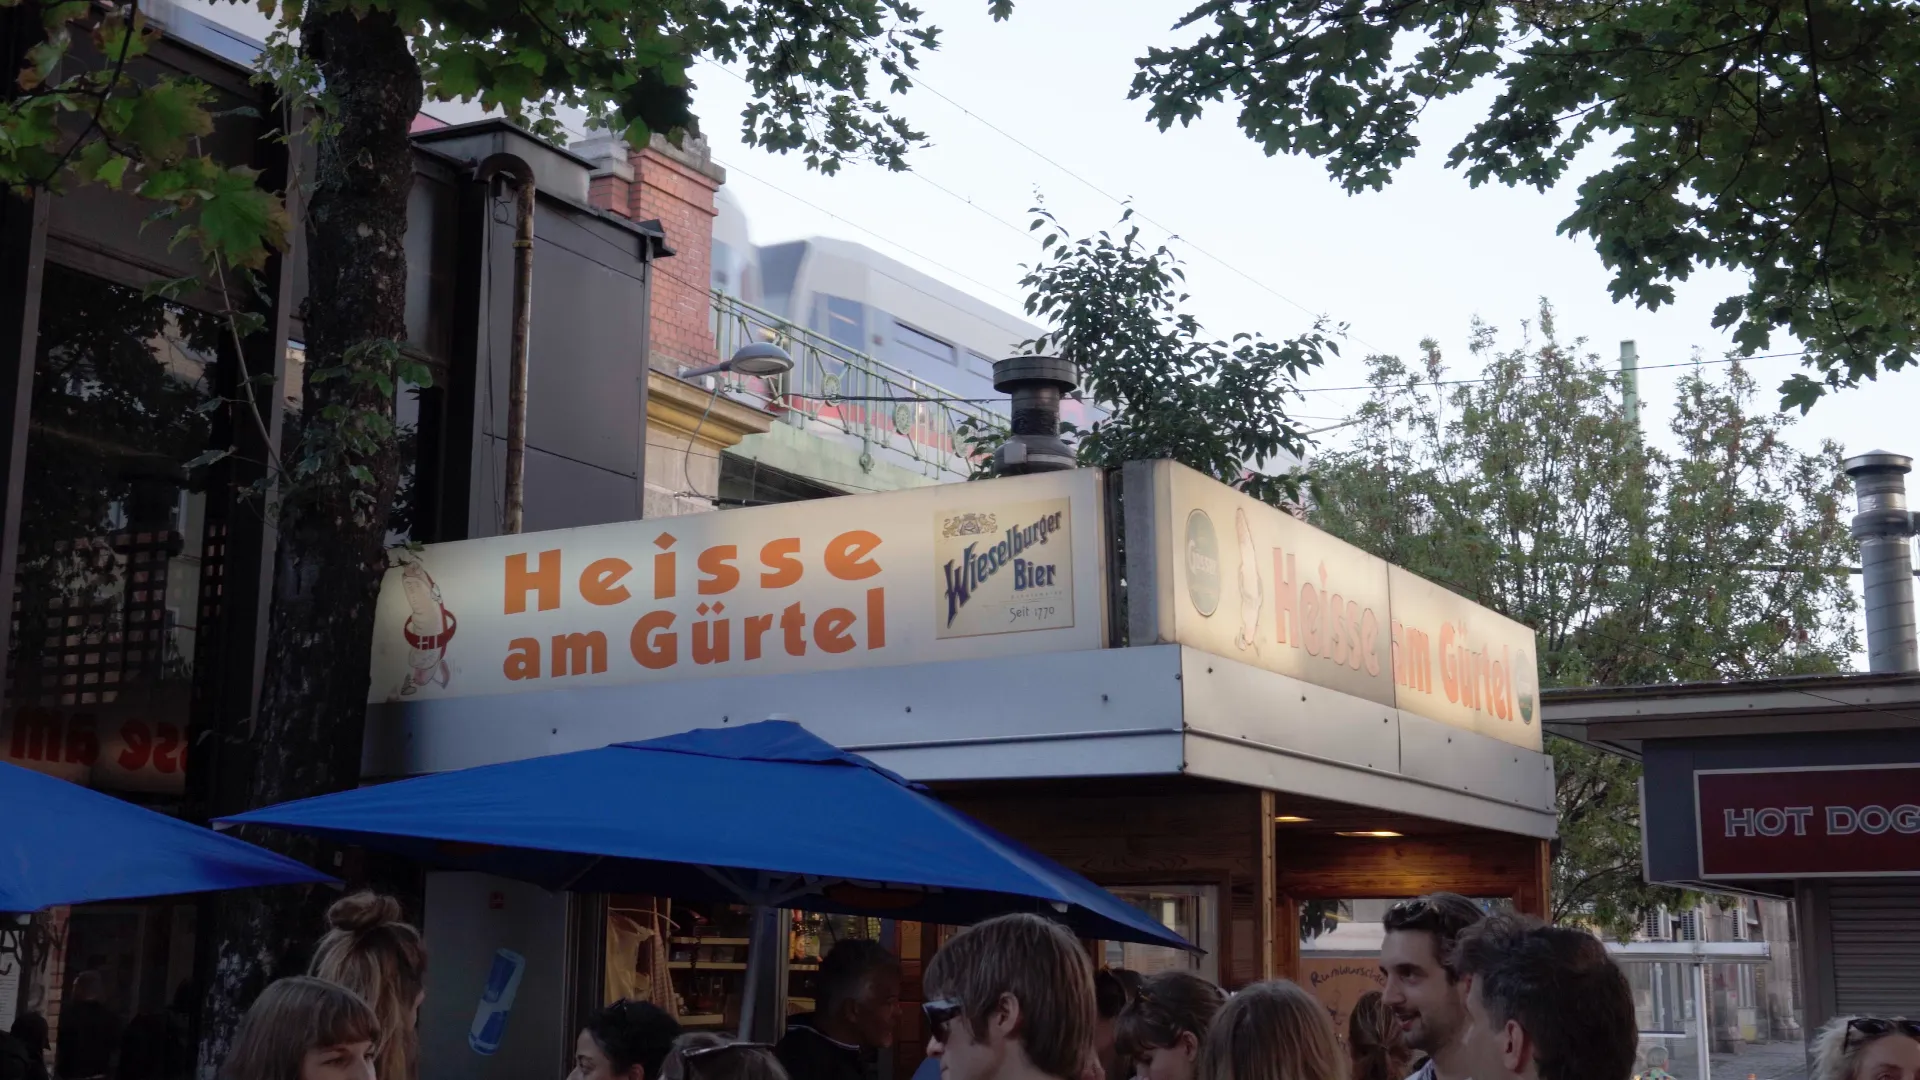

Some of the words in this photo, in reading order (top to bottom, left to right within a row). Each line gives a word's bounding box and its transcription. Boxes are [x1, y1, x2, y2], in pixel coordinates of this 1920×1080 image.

[504, 529, 883, 615] Heisse
[943, 511, 1061, 629] Wieselburger
[1014, 558, 1057, 591] Bier
[503, 630, 607, 682] am
[630, 587, 886, 671] Gürtel
[1009, 606, 1030, 623] Seit
[1034, 606, 1055, 620] 1770
[1272, 547, 1380, 677] Heisse
[1391, 618, 1433, 694] am
[1438, 617, 1513, 721] Gürtel
[1724, 806, 1814, 838] HOT
[1825, 804, 1920, 836] DOG
